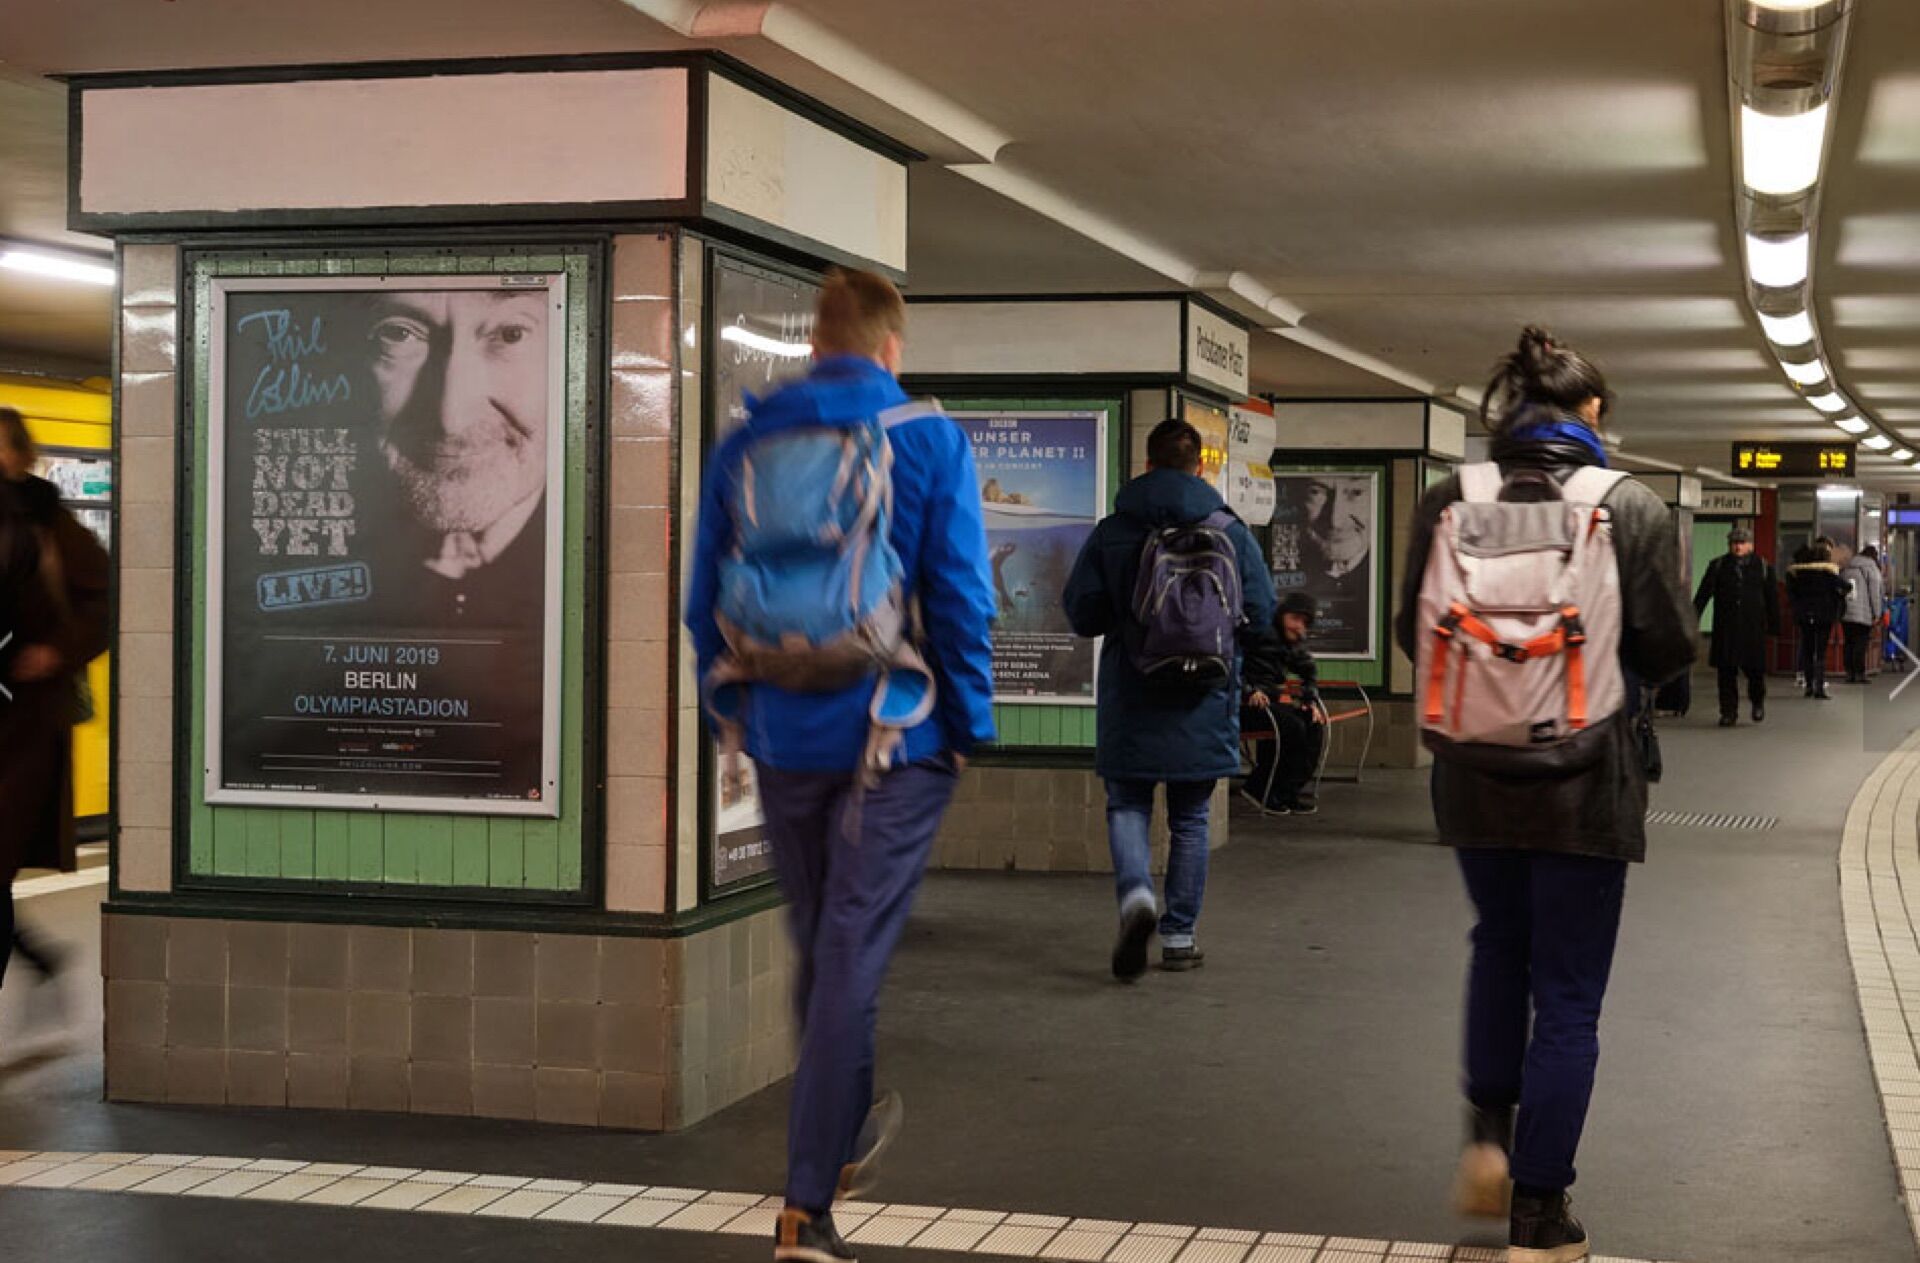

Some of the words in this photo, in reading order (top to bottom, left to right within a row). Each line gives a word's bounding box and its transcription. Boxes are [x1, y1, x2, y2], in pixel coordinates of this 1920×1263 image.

[238, 309, 326, 361] Phil
[254, 428, 357, 454] STILL
[973, 431, 1032, 444] UNSER
[972, 447, 989, 458] ER
[997, 447, 1066, 458] PLANET
[252, 455, 357, 490] NOT
[252, 491, 355, 517] DEAD
[252, 519, 357, 555] YET
[262, 568, 364, 606] LIVE!
[324, 645, 336, 663] 7.
[343, 647, 389, 665] JUNI
[395, 647, 439, 665] 2019
[345, 672, 417, 690] BERLIN
[294, 695, 469, 718] OLYMPIASTADION
